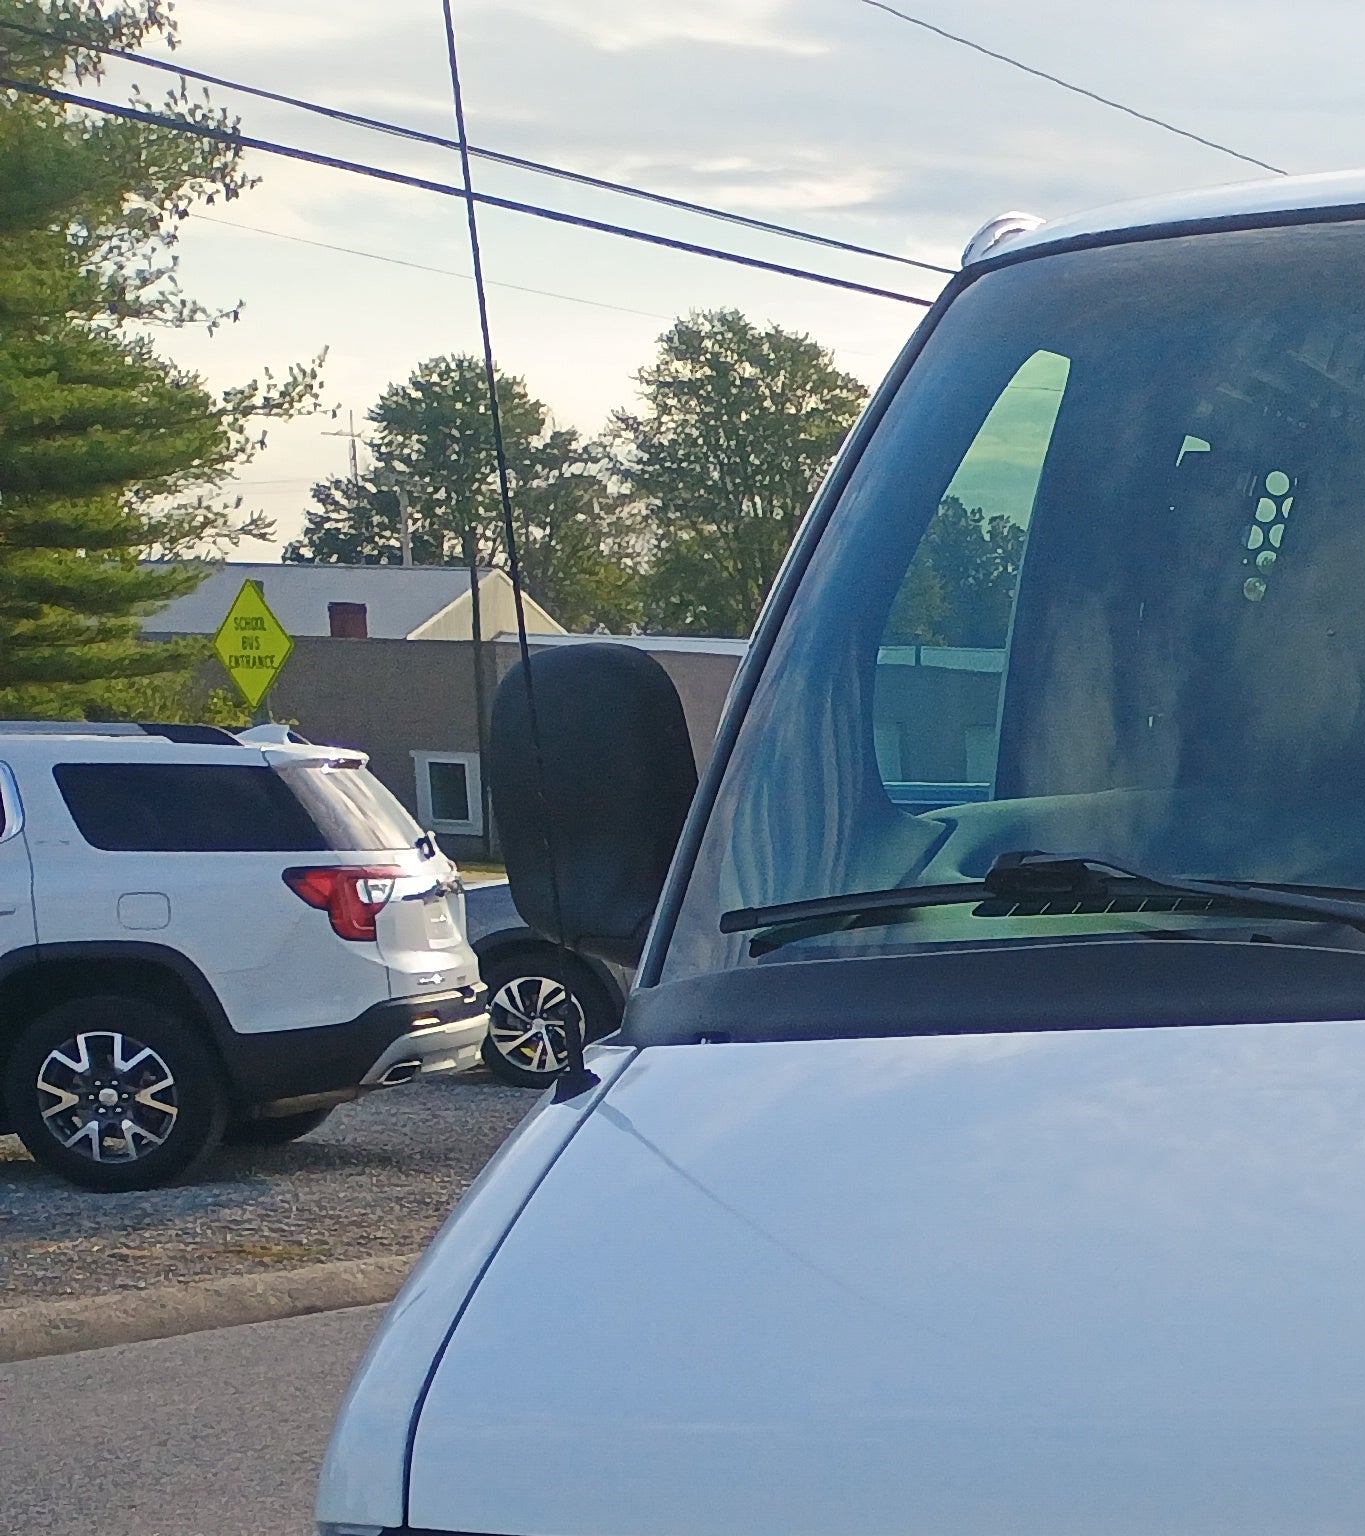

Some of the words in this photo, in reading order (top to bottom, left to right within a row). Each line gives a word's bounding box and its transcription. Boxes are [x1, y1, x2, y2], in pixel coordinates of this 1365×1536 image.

[234, 616, 267, 631] SCHOOL
[241, 635, 260, 650] BUS
[229, 654, 278, 669] ENTRANCE
